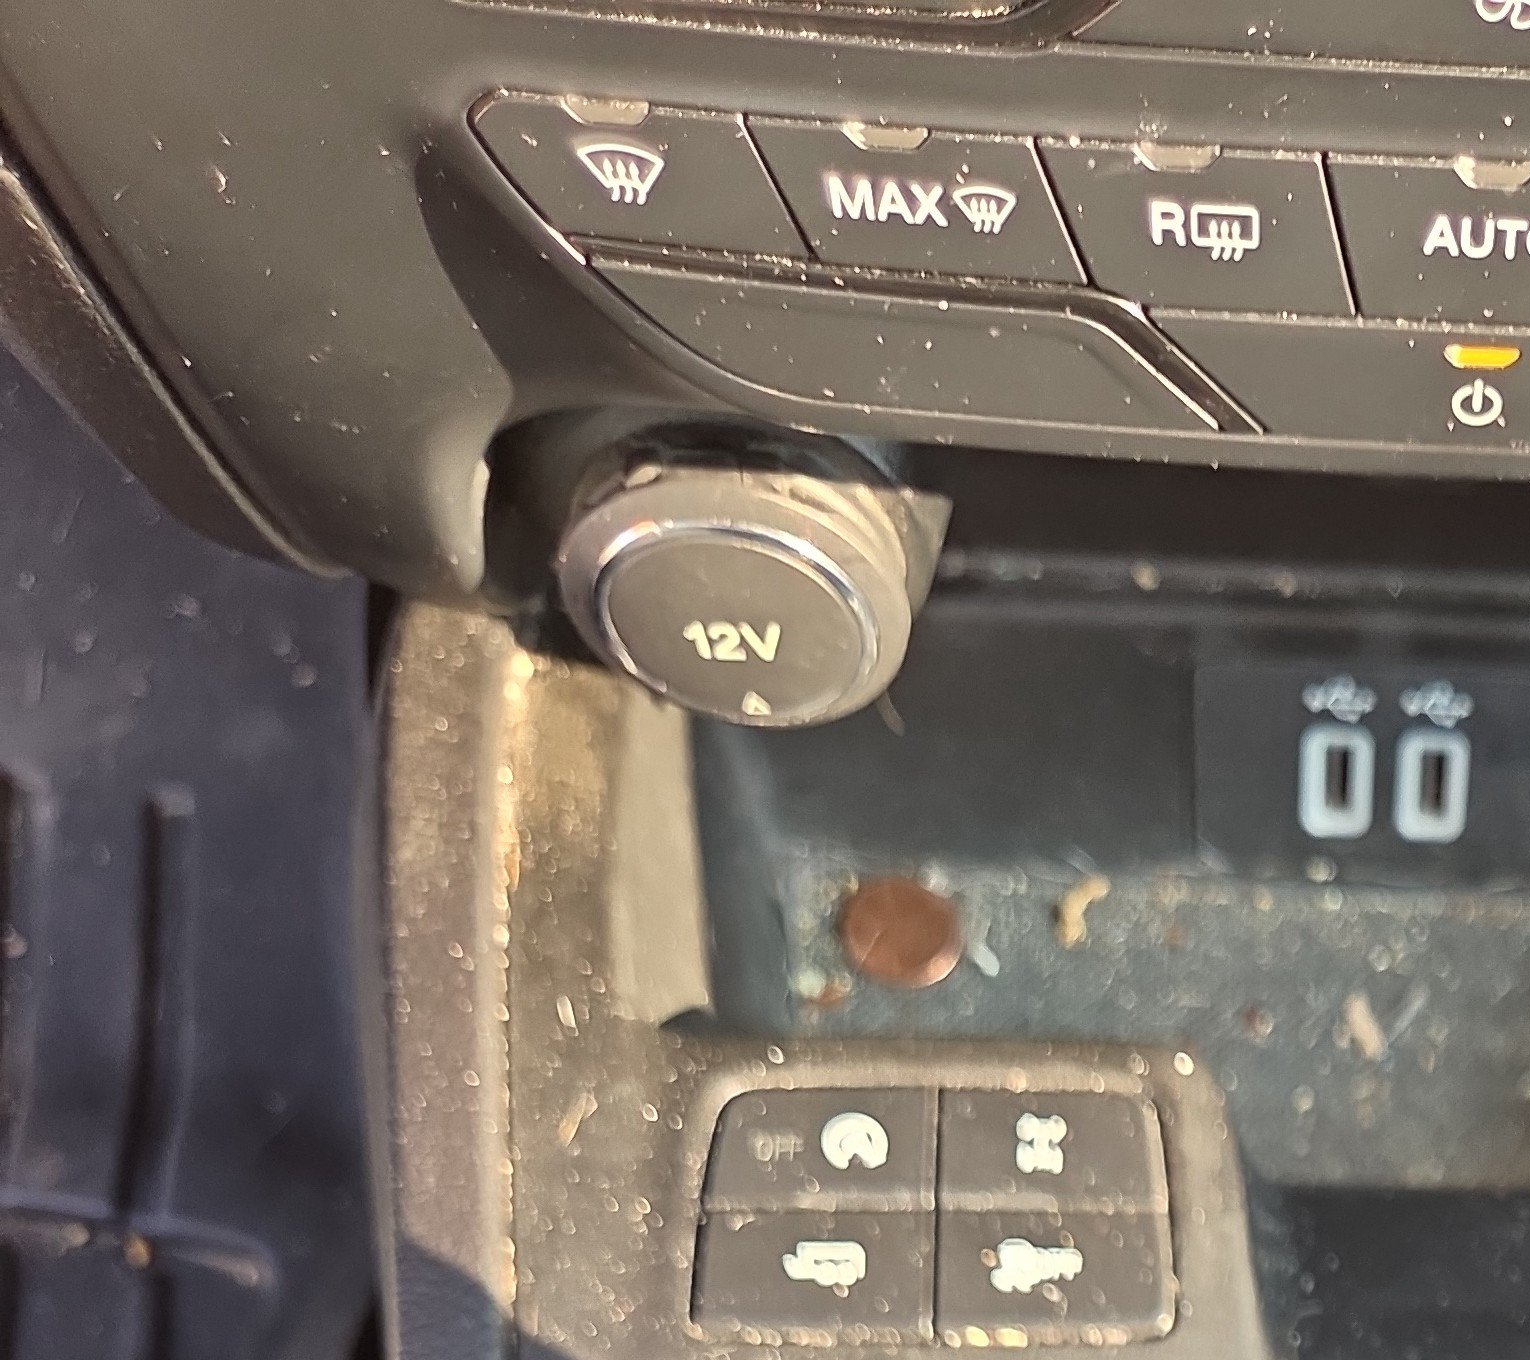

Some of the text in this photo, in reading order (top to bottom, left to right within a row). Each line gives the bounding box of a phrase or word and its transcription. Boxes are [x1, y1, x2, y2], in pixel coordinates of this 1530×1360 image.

[827, 173, 949, 228] MAX
[1149, 199, 1187, 247] R
[683, 620, 781, 662] 12V
